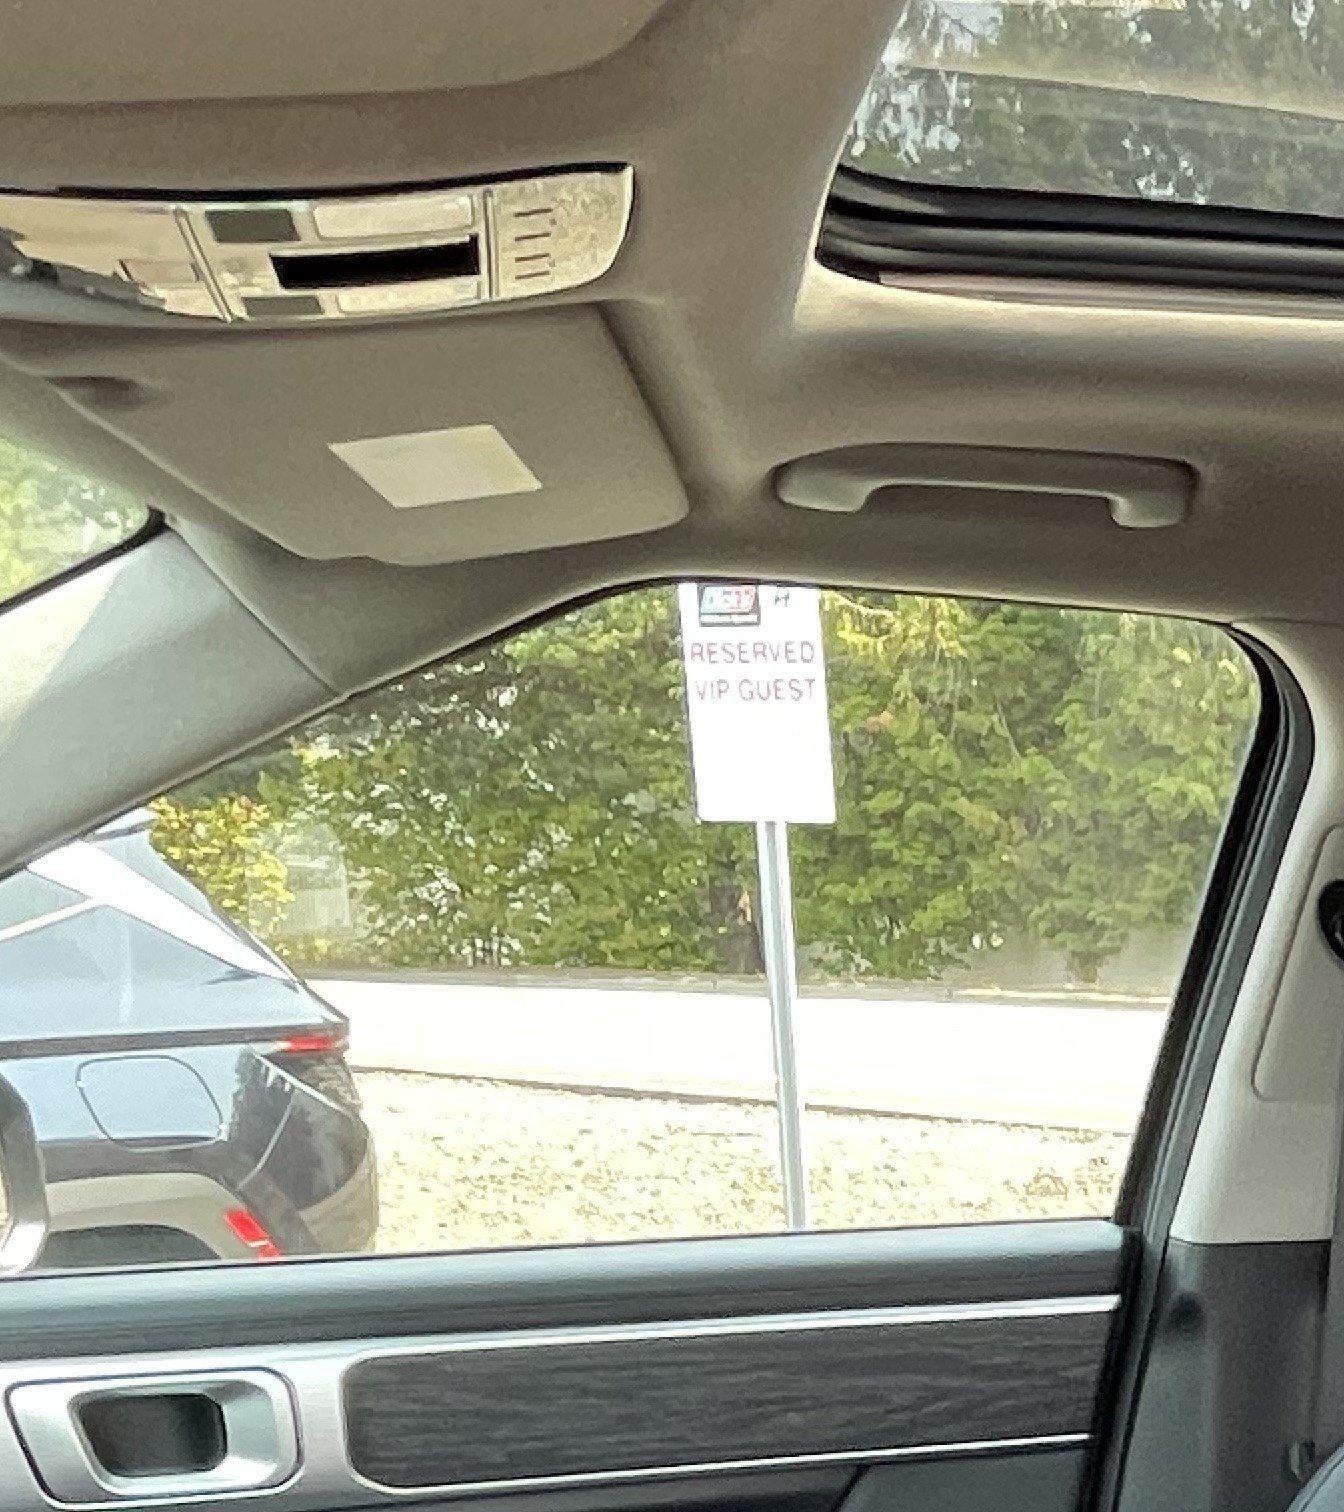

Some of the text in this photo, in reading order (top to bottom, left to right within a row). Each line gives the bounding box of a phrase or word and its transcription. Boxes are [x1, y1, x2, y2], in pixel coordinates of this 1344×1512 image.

[691, 641, 814, 663] RESERVED
[695, 678, 815, 701] VIP GUEST
